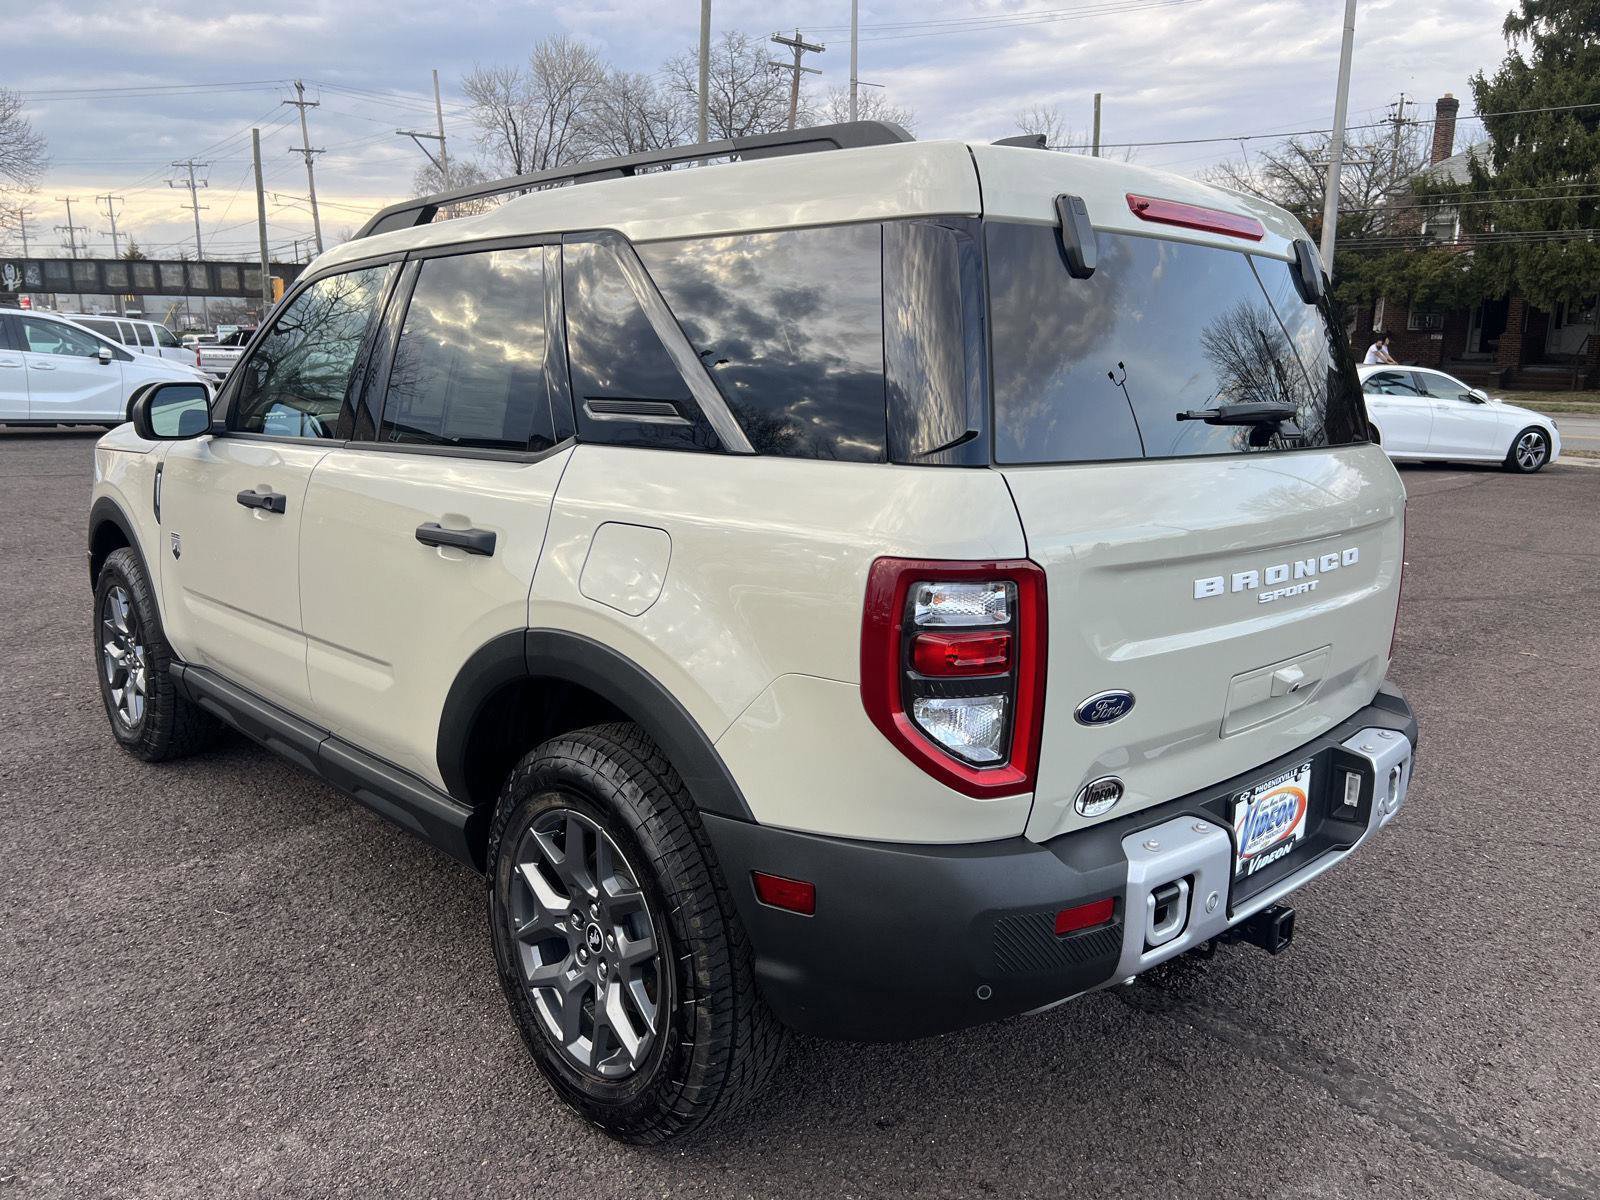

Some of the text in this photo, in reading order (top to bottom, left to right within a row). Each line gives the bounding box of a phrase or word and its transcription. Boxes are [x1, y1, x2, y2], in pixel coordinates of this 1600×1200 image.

[1193, 547, 1359, 599] BRONCO
[1257, 580, 1320, 604] SPORT
[1091, 698, 1125, 720] Ford
[1254, 769, 1298, 795] PHOENIXVILLE
[1240, 797, 1299, 860] VIDEON
[1247, 842, 1293, 876] VIDEON
